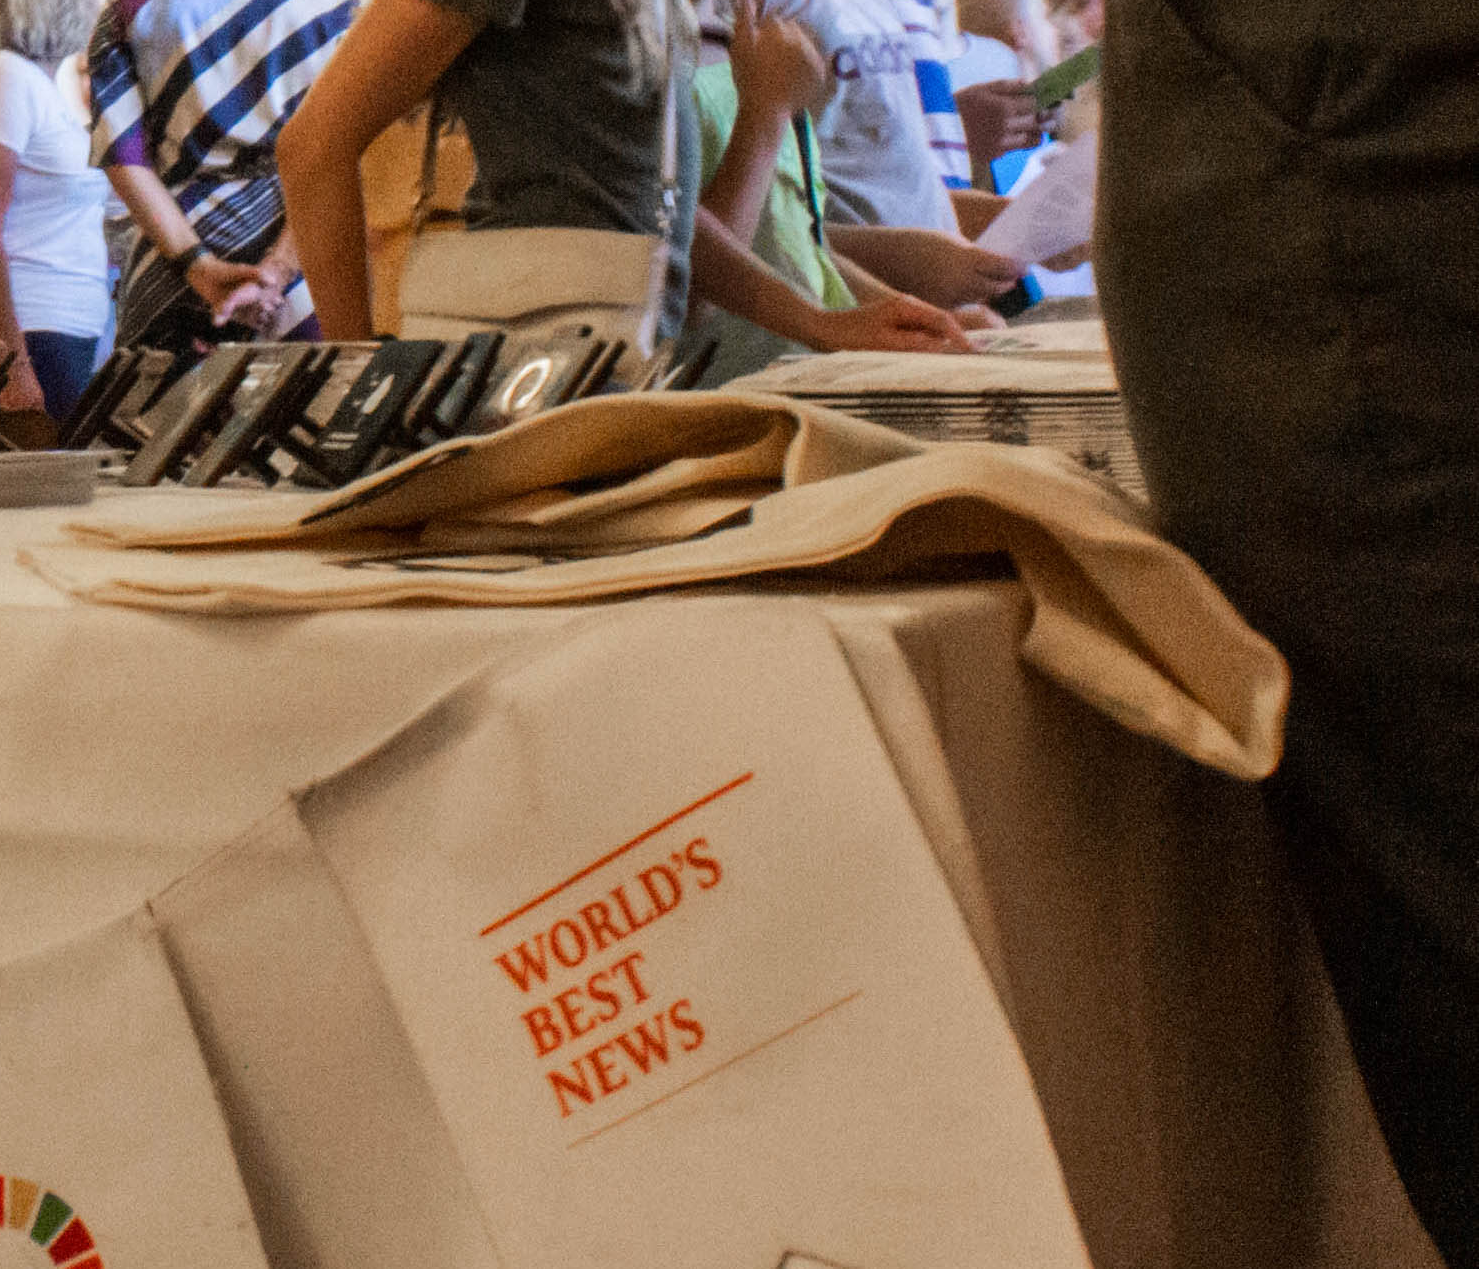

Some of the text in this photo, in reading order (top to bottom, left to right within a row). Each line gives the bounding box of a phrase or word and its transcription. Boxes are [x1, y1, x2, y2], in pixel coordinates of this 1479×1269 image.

[493, 837, 723, 994] WORLD'S
[520, 950, 650, 1059] BEST
[545, 998, 705, 1119] NEWS
